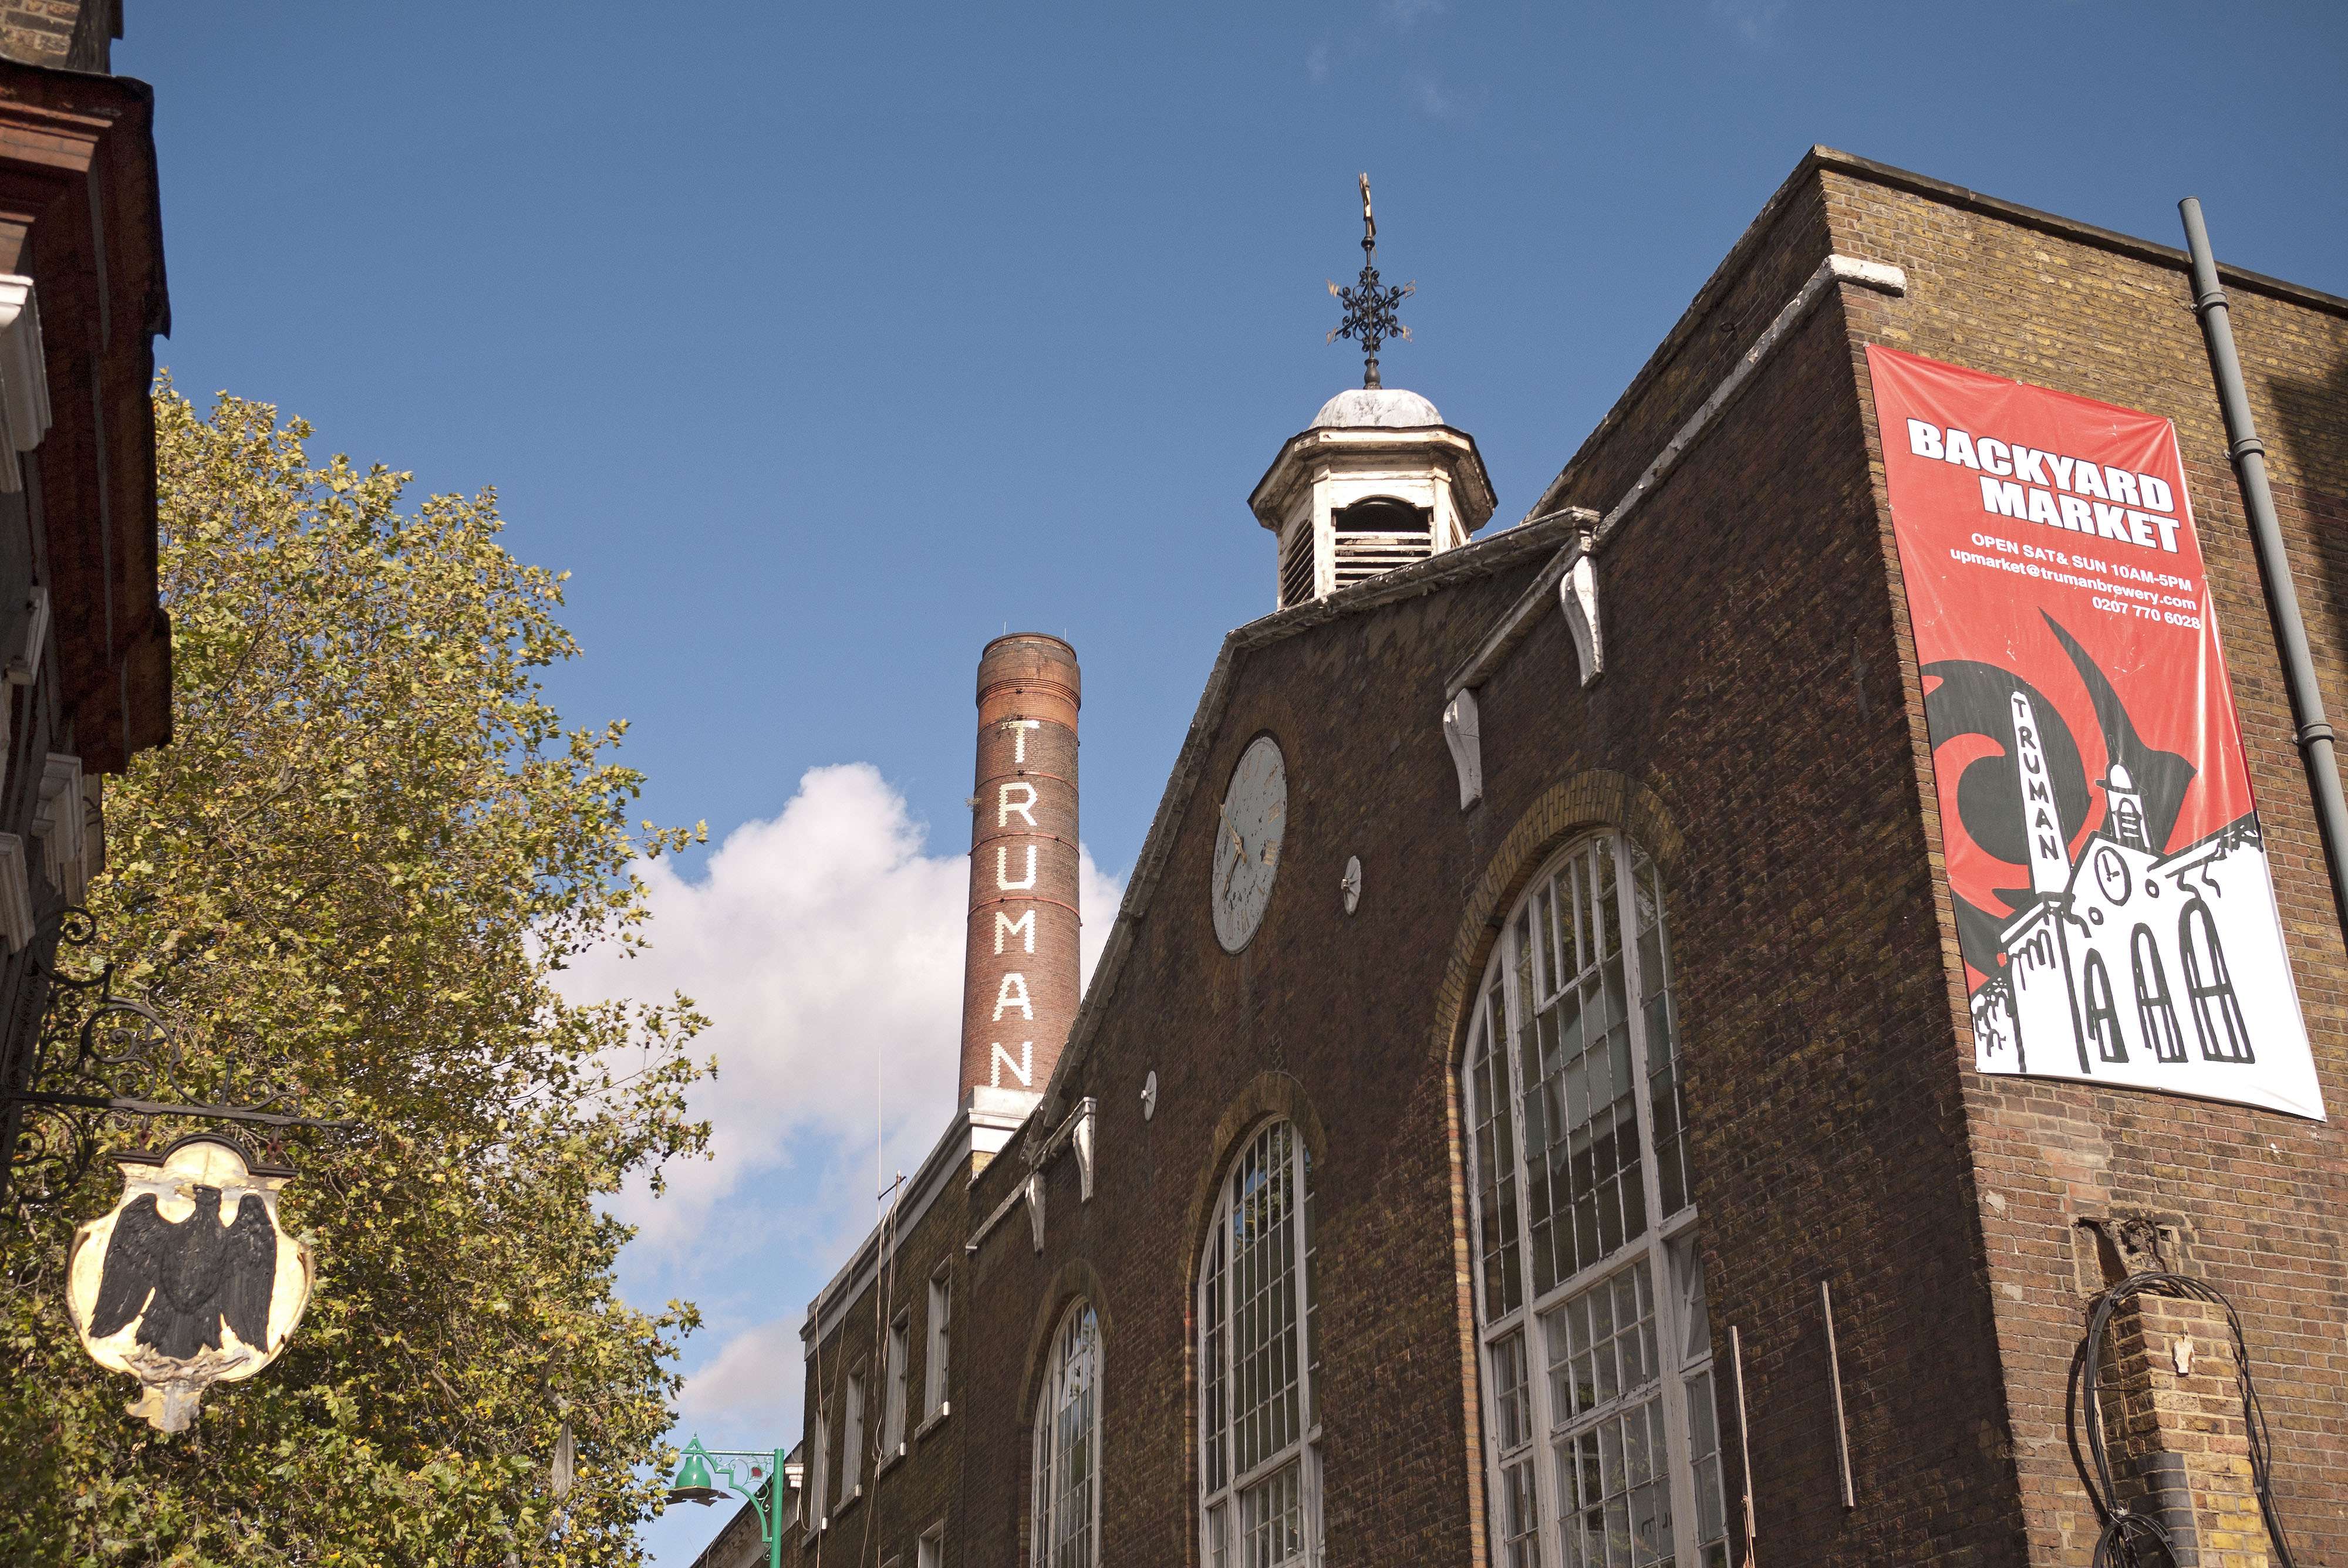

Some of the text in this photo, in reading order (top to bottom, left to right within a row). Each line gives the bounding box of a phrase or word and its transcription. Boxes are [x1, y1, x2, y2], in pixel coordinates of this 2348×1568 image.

[1907, 417, 2175, 513] BACKYARD
[1978, 475, 2180, 553] MARKET
[1950, 549, 2197, 610] upmarket@trumanbrewery.com
[1971, 532, 2019, 555] OPEN
[2072, 555, 2107, 574] SUN
[2111, 564, 2192, 592] 10AM-5PM
[2092, 596, 2202, 630] 0207 770 6028
[2013, 698, 2059, 860] TRUMAN
[990, 719, 1040, 1087] TRUMAN
